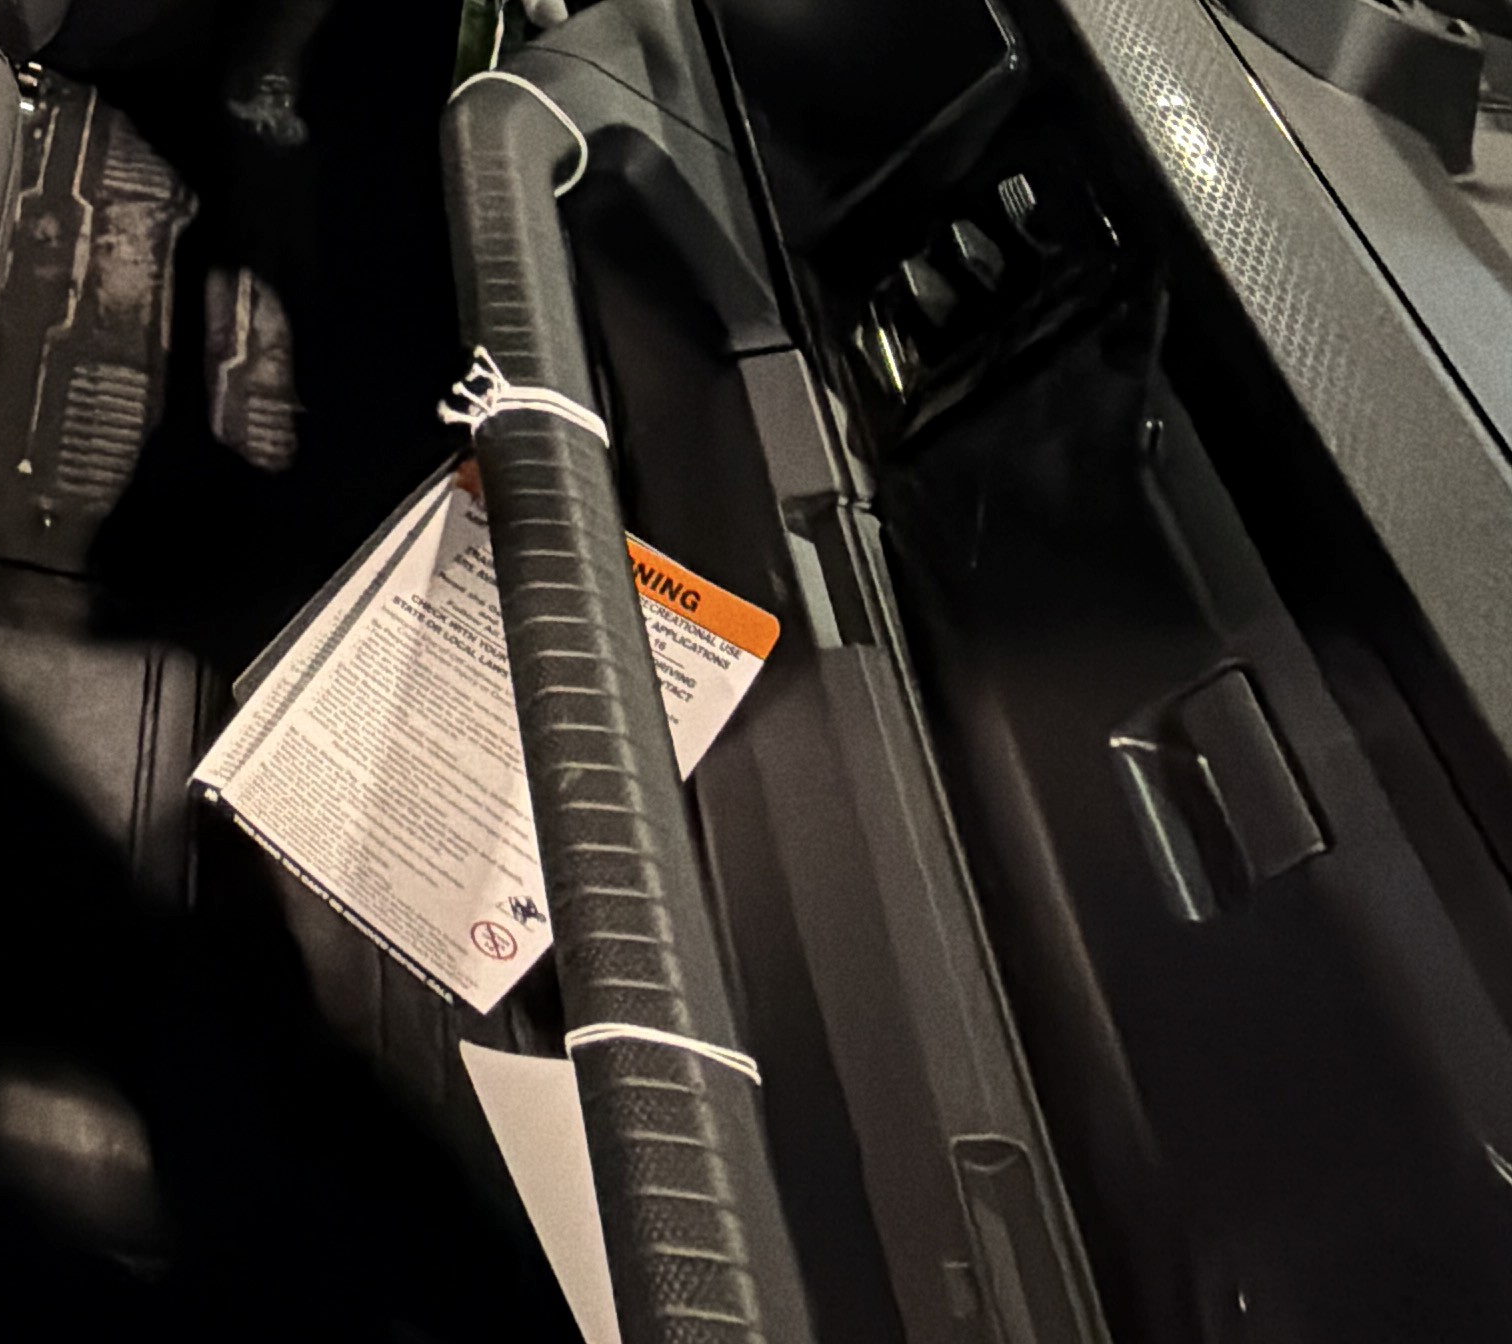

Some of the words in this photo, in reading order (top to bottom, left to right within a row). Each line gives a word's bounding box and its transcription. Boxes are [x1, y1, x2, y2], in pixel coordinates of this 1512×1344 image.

[634, 562, 702, 614] NING
[392, 595, 426, 622] STATE
[425, 618, 443, 634] OR
[443, 628, 477, 659] LOCAL
[411, 594, 447, 623] CHECK
[448, 615, 478, 644] WITH
[651, 621, 732, 670] APPLICATIONS
[719, 641, 742, 661] USE
